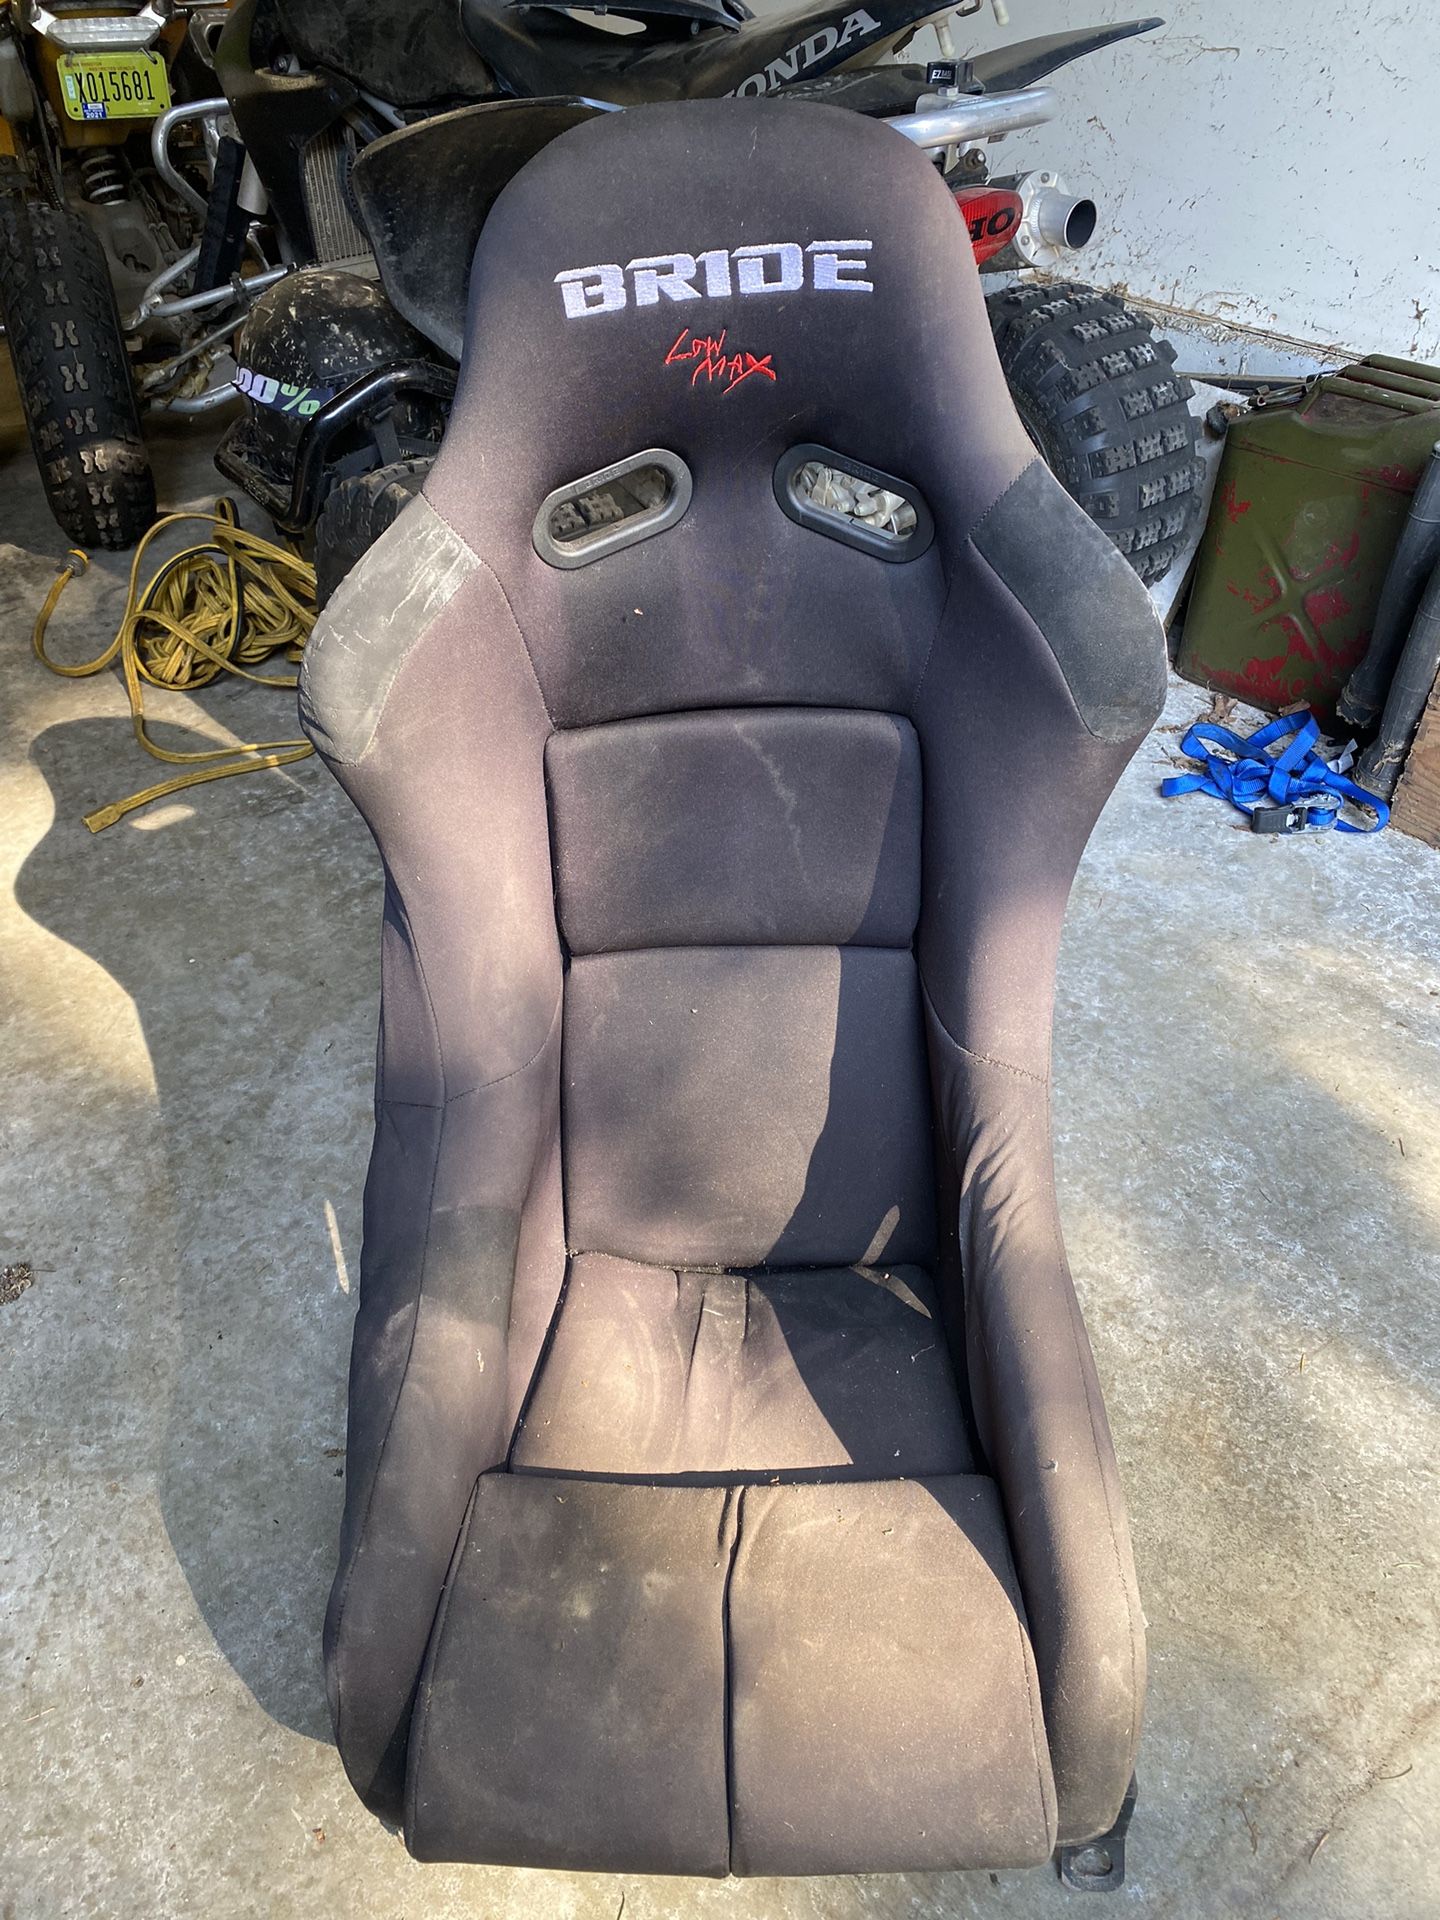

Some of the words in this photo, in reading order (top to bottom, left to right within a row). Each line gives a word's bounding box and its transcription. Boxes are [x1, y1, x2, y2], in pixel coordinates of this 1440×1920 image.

[722, 8, 882, 98] ONDA
[75, 70, 155, 104] X015681
[553, 240, 874, 319] BRIDE
[692, 352, 777, 394] MAX
